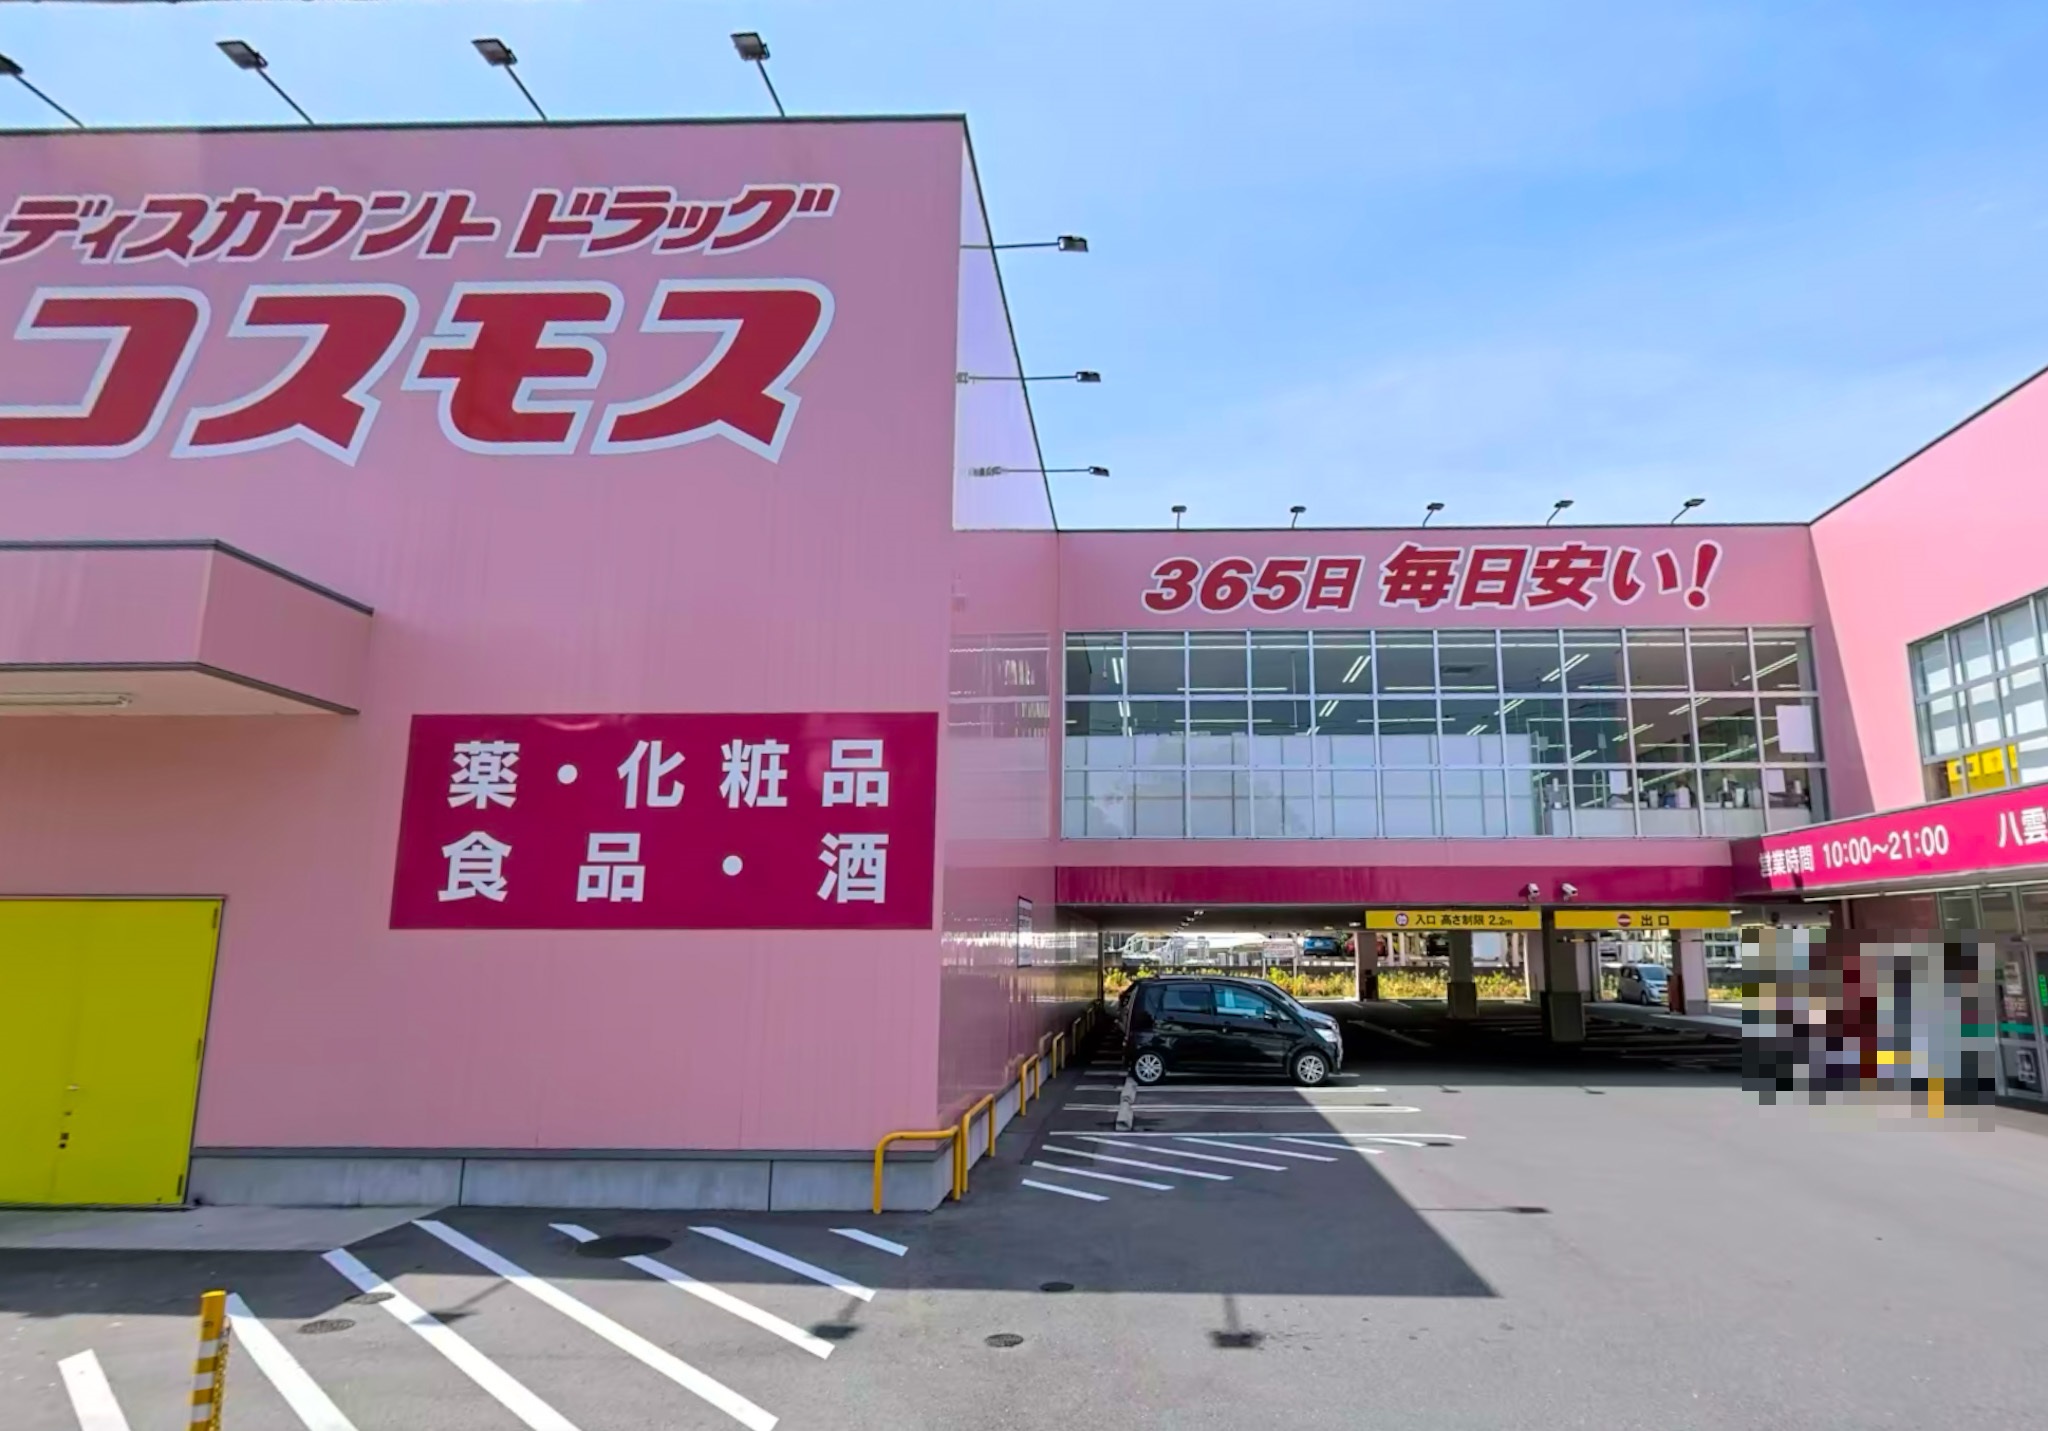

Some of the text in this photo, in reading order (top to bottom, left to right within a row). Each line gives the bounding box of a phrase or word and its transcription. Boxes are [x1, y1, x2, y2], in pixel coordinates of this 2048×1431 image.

[0, 182, 840, 266] ディスカウント ドラッグ
[0, 279, 836, 467] コスモス
[1141, 555, 1366, 613] 365日
[447, 738, 890, 810] 薬・化粧品
[1998, 805, 2048, 848] 八雲
[437, 830, 890, 904] 食品・酒
[1759, 844, 1816, 878] 営業時間
[1415, 913, 1513, 926] 入口 高さ制限 2.2m
[1641, 914, 1670, 927] 出口
